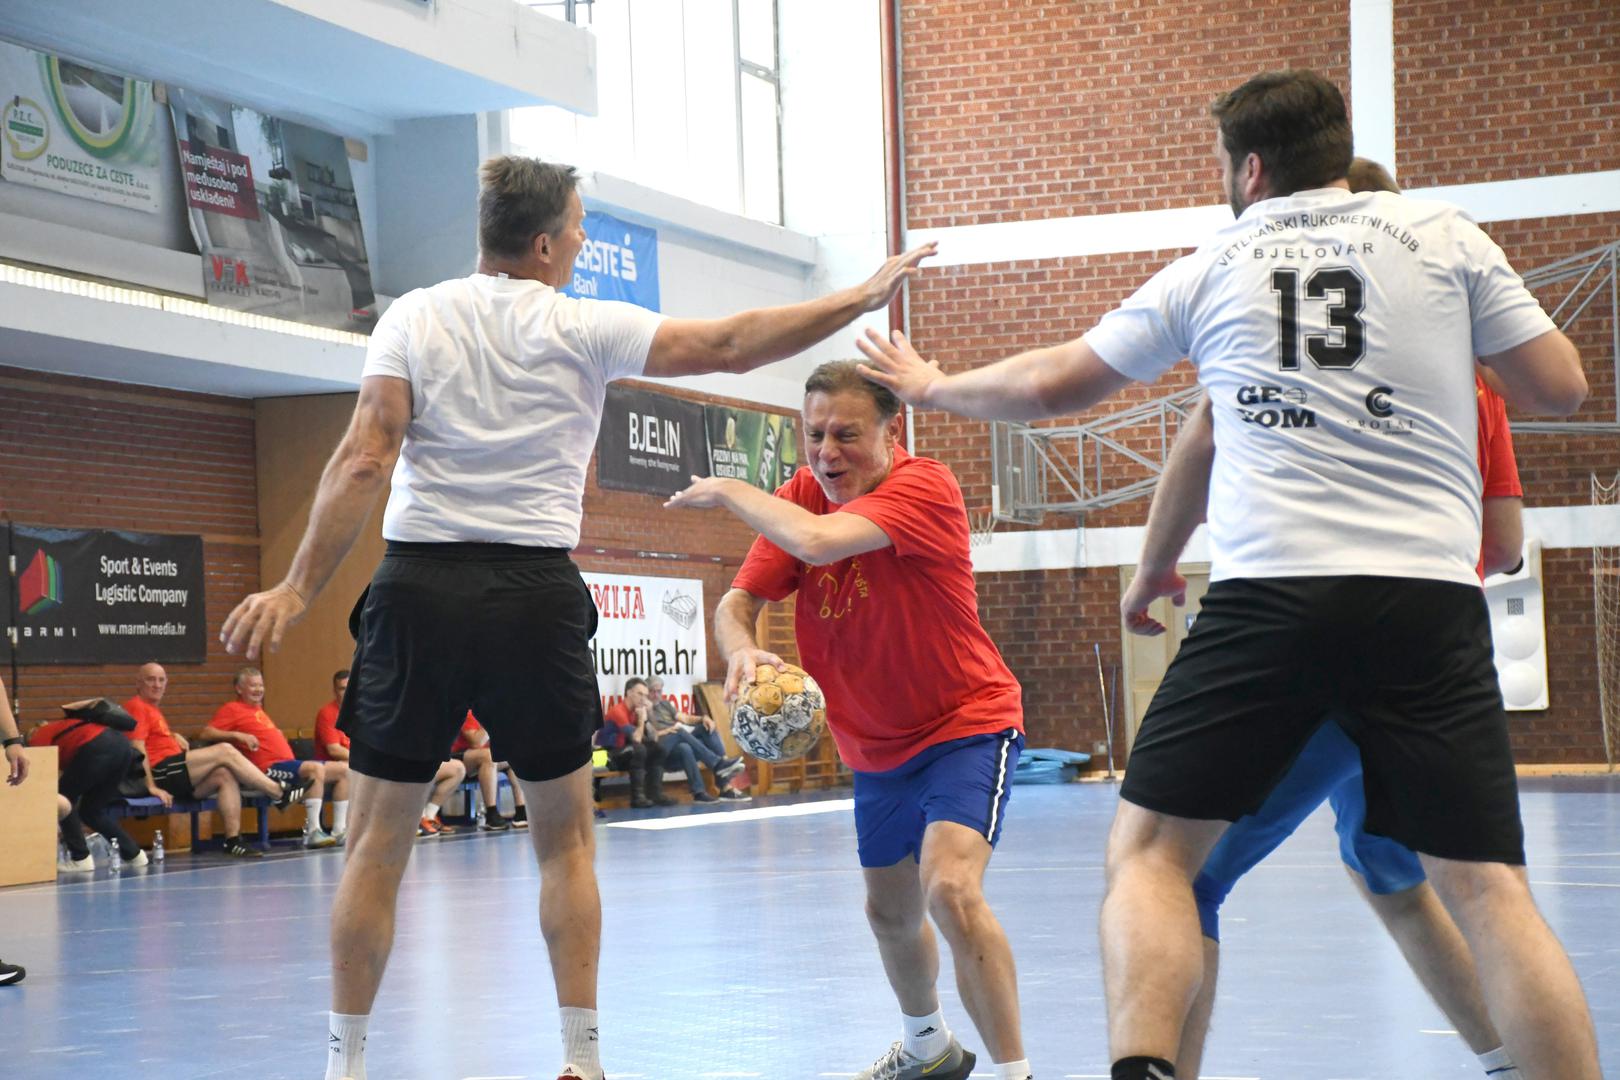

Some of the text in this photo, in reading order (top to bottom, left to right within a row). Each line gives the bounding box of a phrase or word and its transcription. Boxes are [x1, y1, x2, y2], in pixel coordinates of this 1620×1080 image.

[110, 169, 135, 186] CESTE
[231, 163, 248, 178] pod
[1301, 213, 1382, 230] RUKOMETNI
[1382, 222, 1420, 253] KLUB
[1253, 242, 1374, 260] BJELOVAR
[1270, 265, 1367, 371] 13
[629, 411, 680, 458] BJELIN
[100, 554, 178, 578] Sport & Events
[95, 582, 188, 607] Logistic Company
[587, 584, 645, 619] MIJA
[97, 621, 186, 636] www.marmi-media.hr
